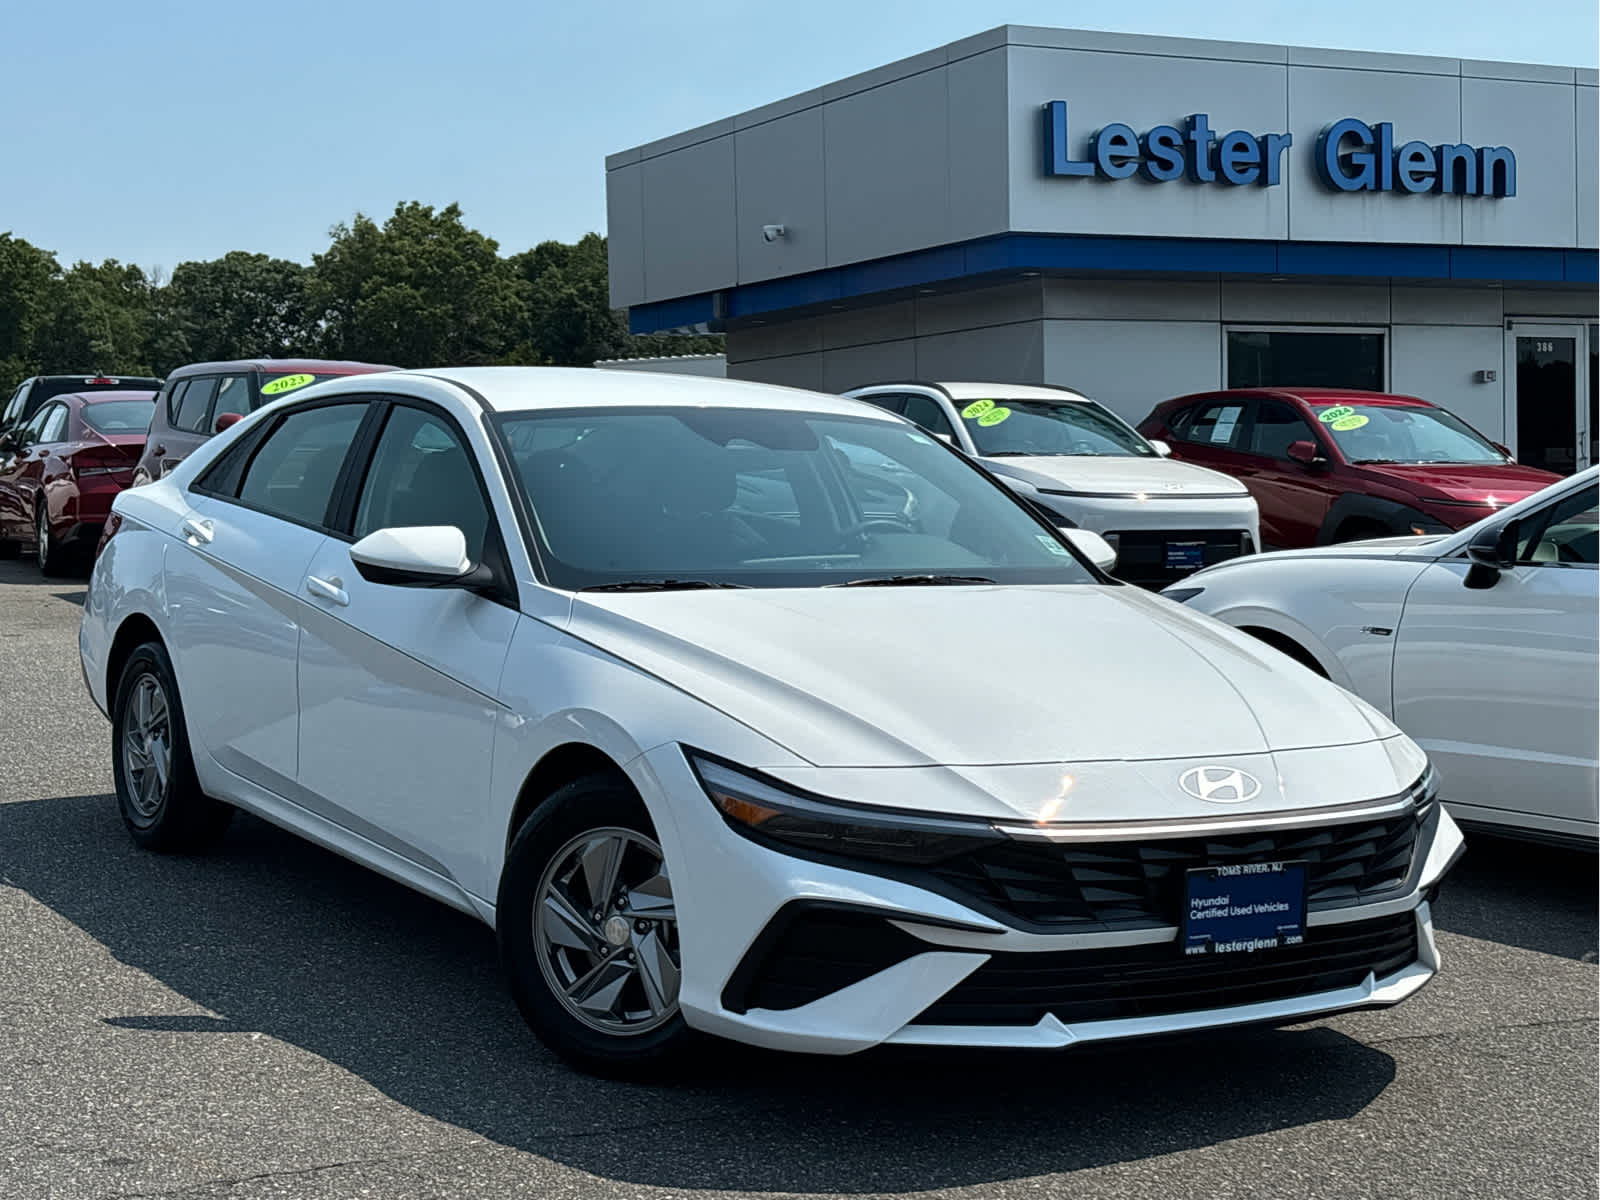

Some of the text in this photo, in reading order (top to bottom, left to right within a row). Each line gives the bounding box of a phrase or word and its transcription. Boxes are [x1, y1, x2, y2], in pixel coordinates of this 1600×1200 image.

[1043, 99, 1517, 198] Lester Glenn
[272, 375, 305, 392] 2023
[1322, 407, 1351, 421] 2024
[1216, 865, 1241, 876] TOMS
[1191, 895, 1230, 909] Hyundai
[1190, 902, 1289, 920] Certified Used Vehicles
[1215, 938, 1278, 953] lesterglenn
